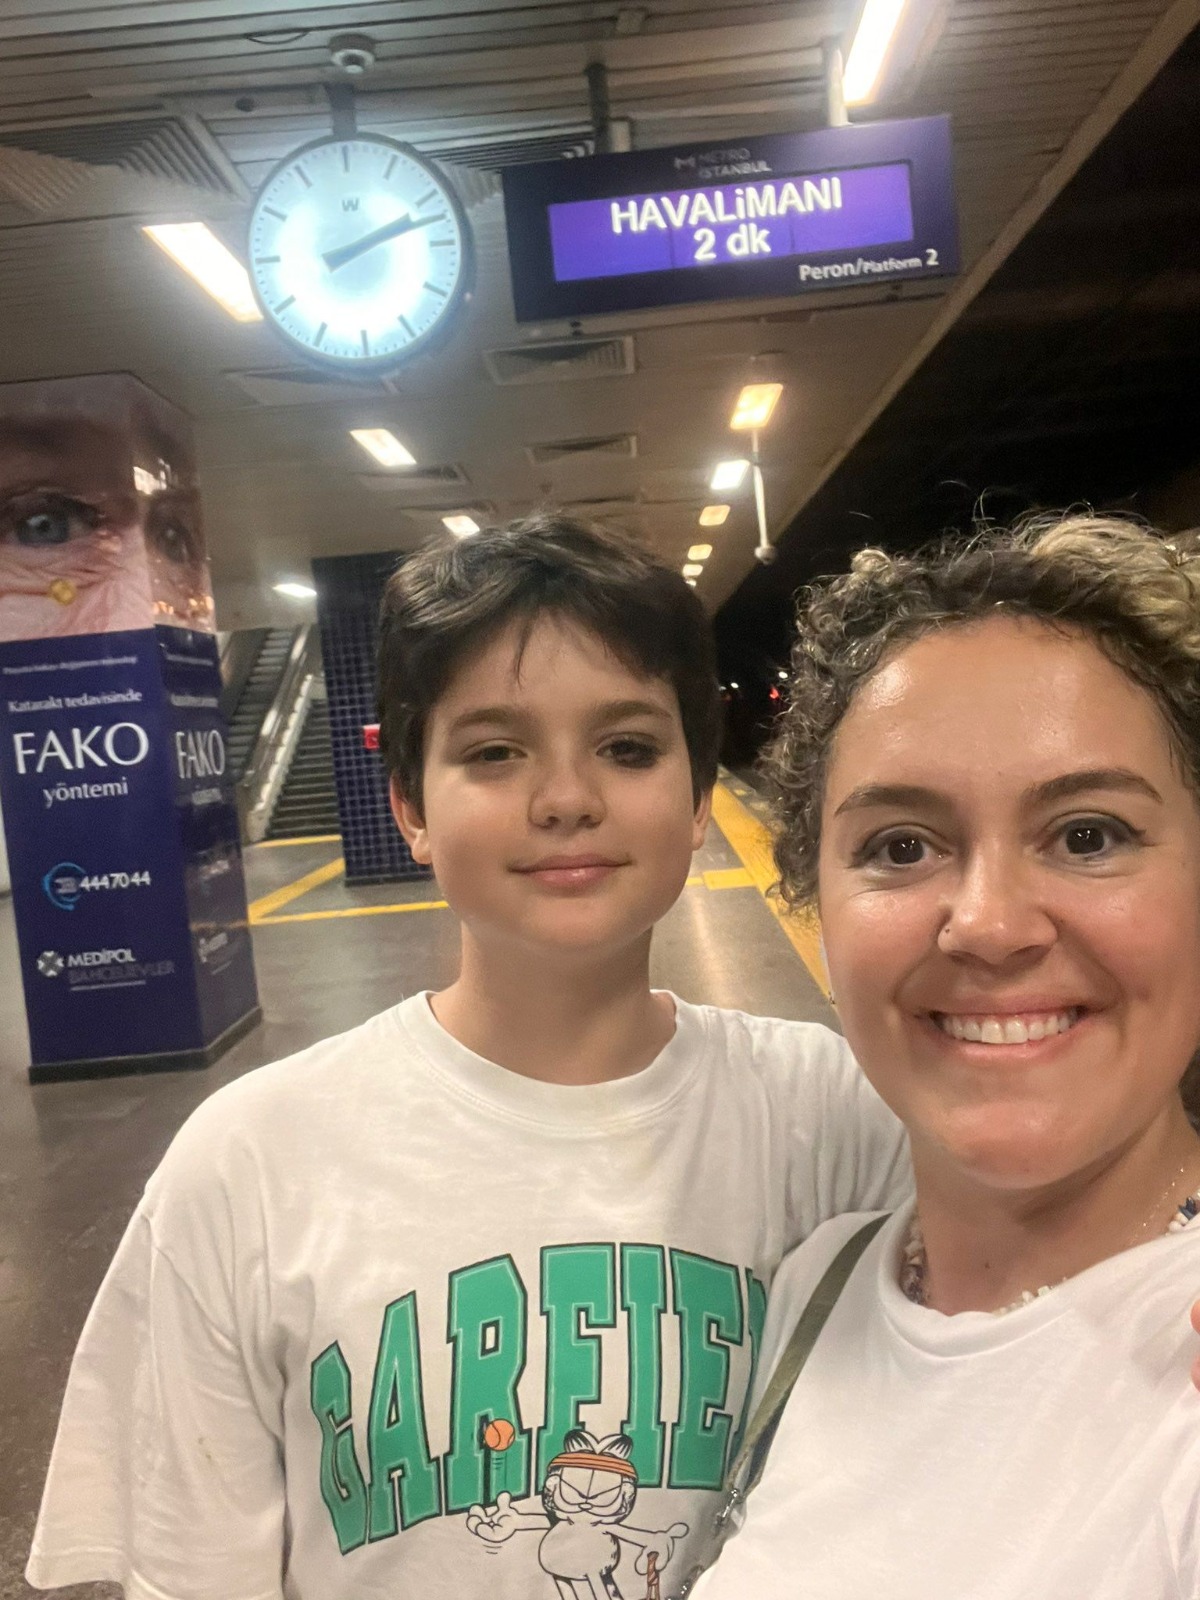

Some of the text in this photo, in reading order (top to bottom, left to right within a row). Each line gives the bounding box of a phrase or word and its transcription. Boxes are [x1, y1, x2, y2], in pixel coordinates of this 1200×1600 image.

[693, 223, 771, 261] 2 dk
[926, 248, 939, 266] 2
[13, 722, 149, 774] FAKO
[175, 729, 225, 779] FAKO
[43, 776, 128, 808] yöntemi
